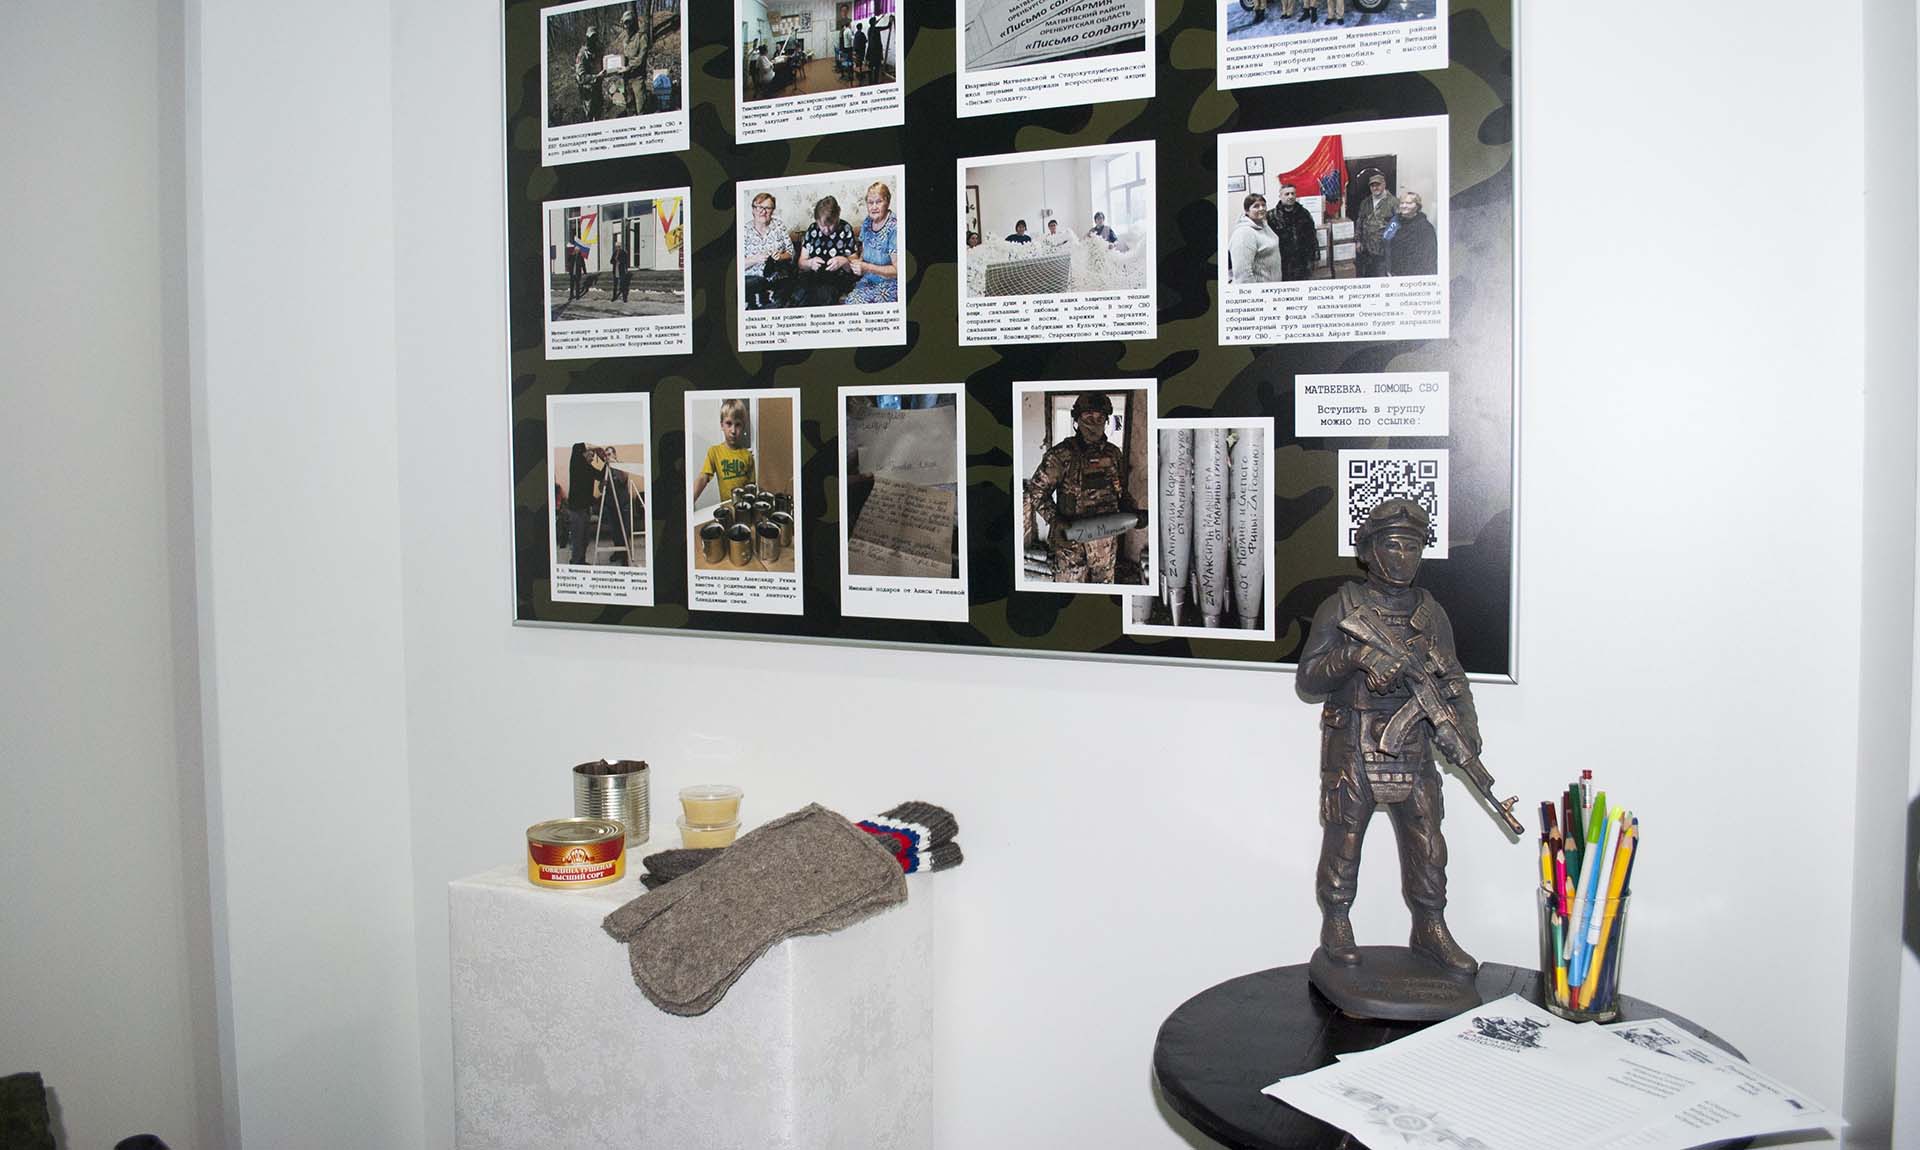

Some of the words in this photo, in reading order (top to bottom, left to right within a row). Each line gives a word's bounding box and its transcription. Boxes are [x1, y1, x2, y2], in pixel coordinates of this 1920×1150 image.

[1000, 8, 1047, 38] «Письмо
[1040, 20, 1094, 35] ОРЕНБУРГСКАЯ
[1096, 10, 1130, 24] ОБЛАСТЬ
[1045, 11, 1098, 26] МАТВЕЕВСКИЙ
[1100, 4, 1126, 15] РАЙОН
[1026, 34, 1078, 50] «Письмо
[1082, 18, 1145, 39] солдату»
[1374, 384, 1412, 393] ПОМОЩЬ
[1419, 384, 1438, 392] СВО
[1317, 405, 1368, 415] Вступить
[1387, 406, 1425, 414] группу
[1320, 418, 1352, 426] можно
[1377, 418, 1420, 426] ссылке:
[586, 872, 604, 880] СОРТ
